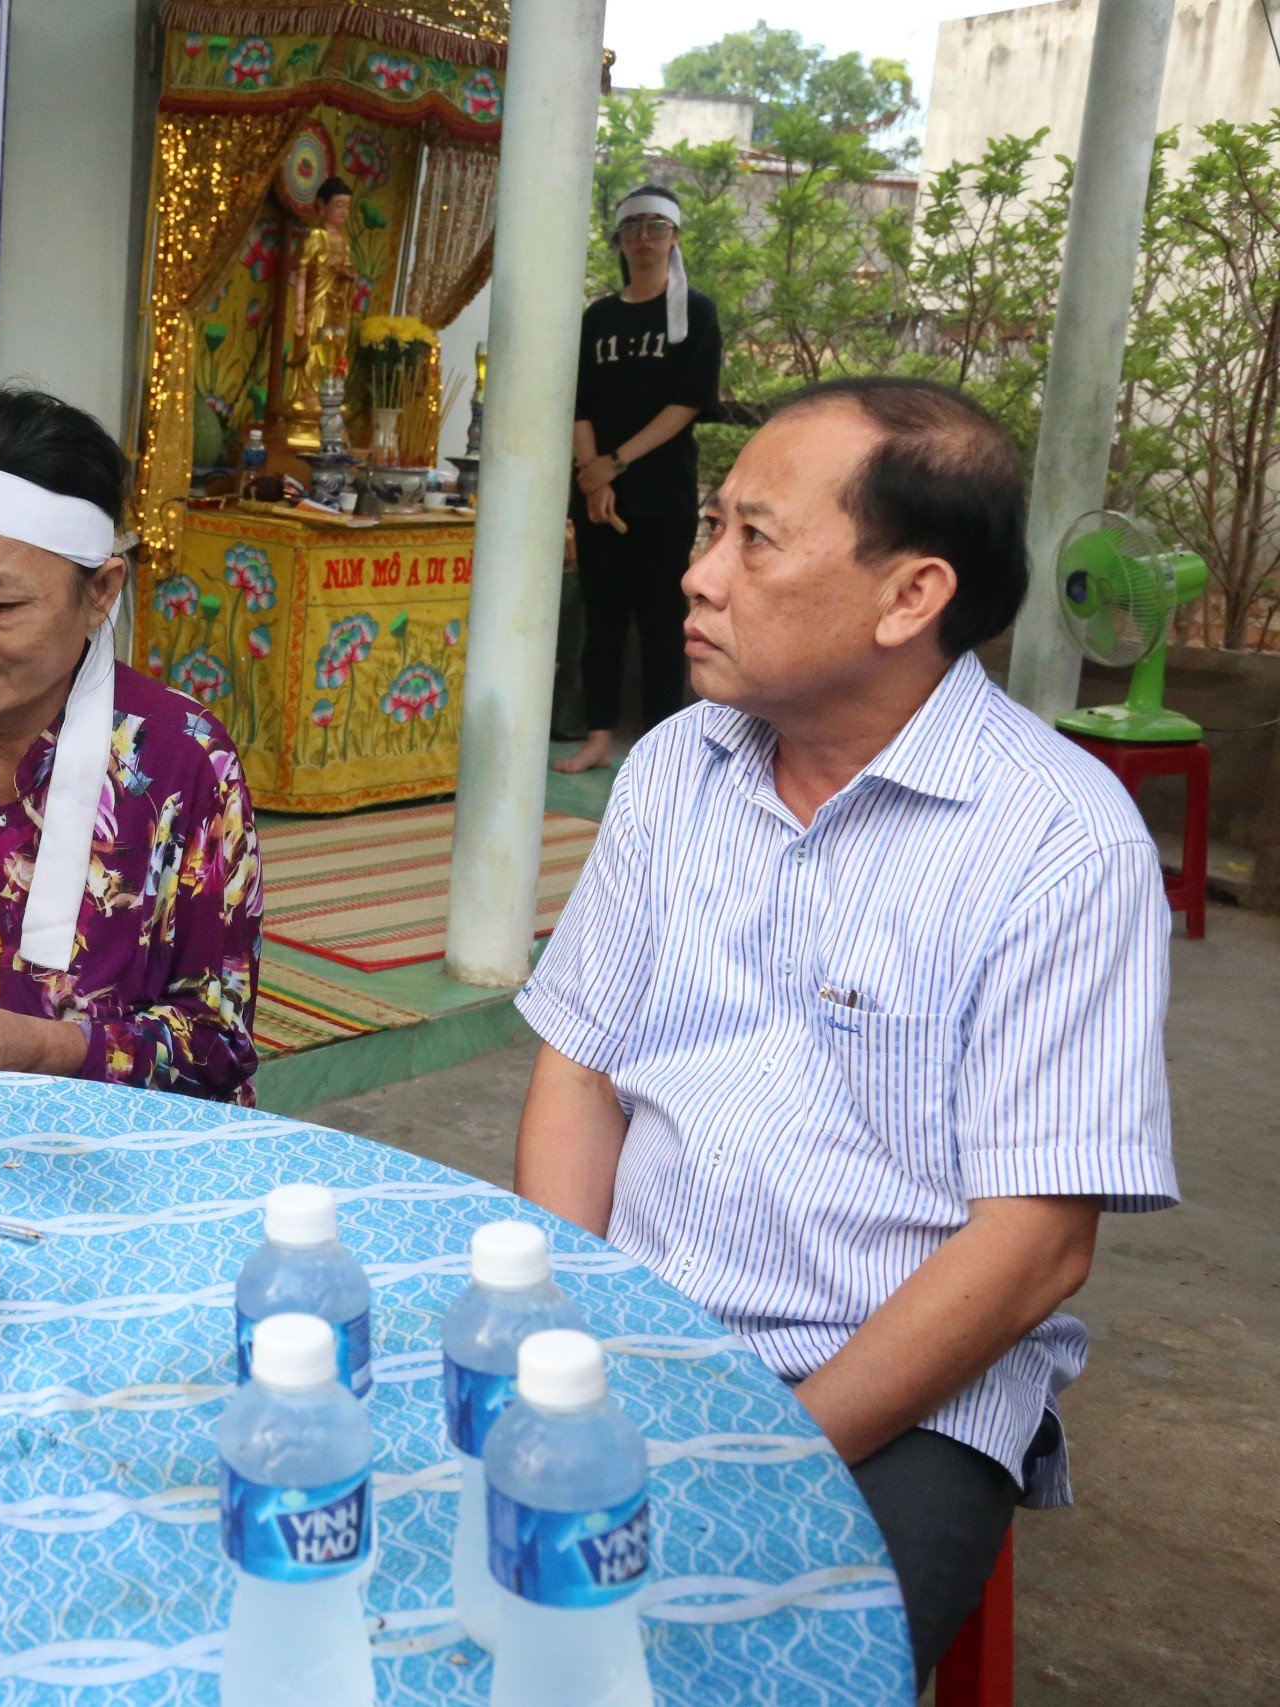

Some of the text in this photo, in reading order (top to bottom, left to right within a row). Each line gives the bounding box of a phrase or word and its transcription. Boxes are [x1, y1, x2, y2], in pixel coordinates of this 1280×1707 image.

[322, 557, 365, 589] NAM
[406, 558, 421, 587] A
[426, 556, 447, 584] DI
